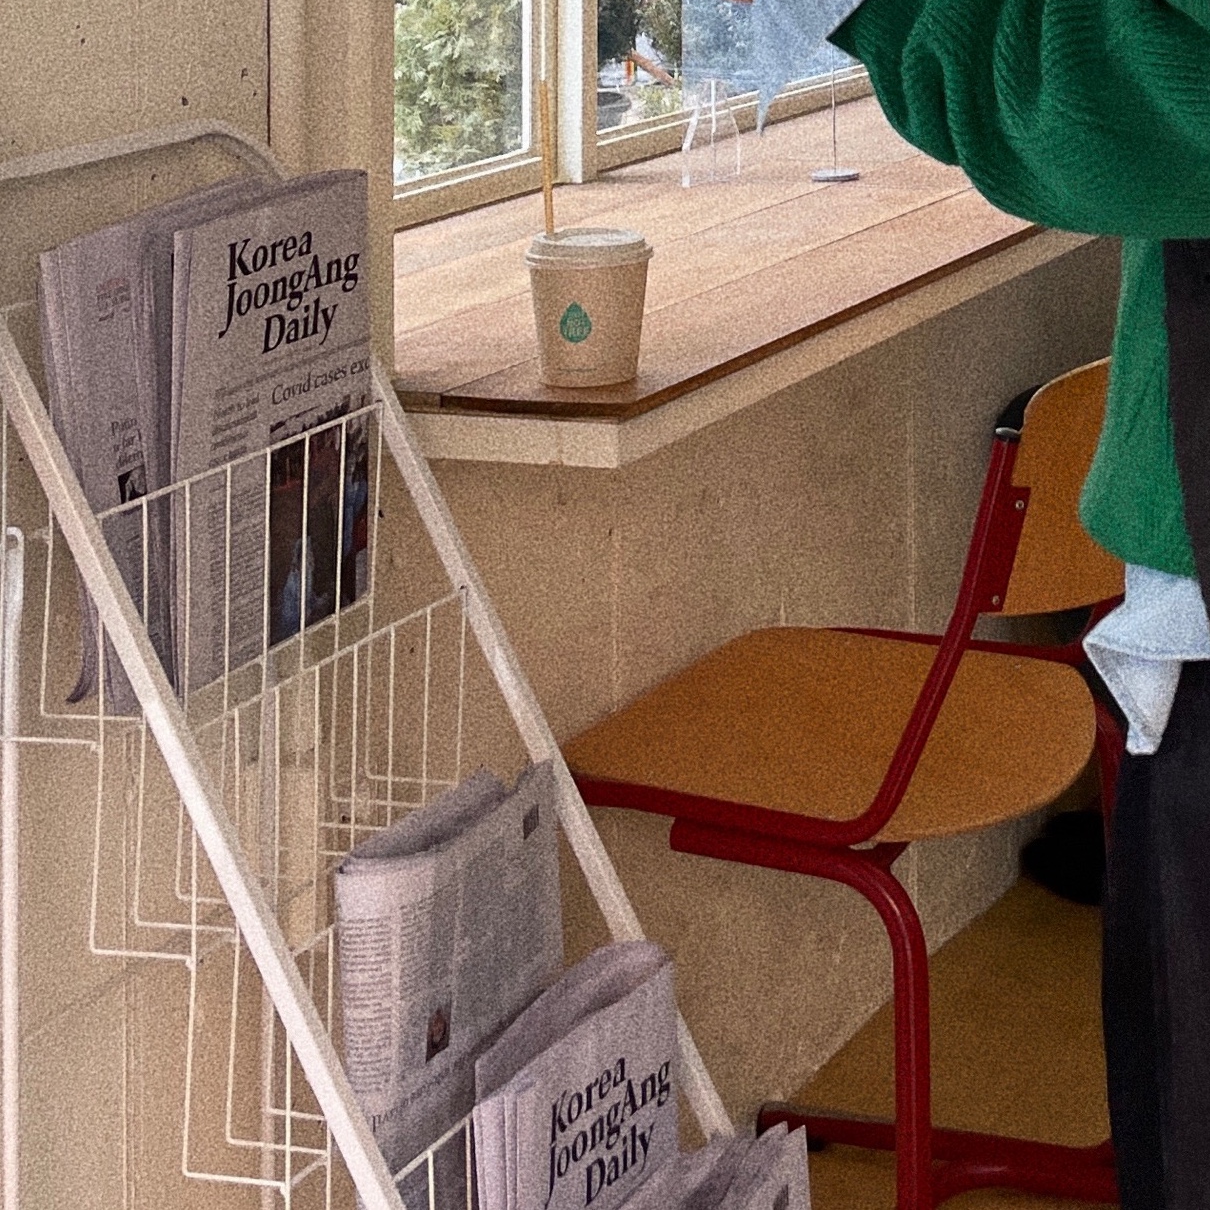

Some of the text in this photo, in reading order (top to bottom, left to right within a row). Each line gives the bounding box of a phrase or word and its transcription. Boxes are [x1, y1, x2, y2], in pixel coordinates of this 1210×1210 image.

[218, 253, 360, 339] JoongAng
[227, 231, 312, 281] Korea
[262, 296, 339, 354] Daily
[272, 369, 312, 405] Covid
[314, 365, 347, 388] cases
[544, 1060, 671, 1210] JoongAng
[550, 1057, 626, 1146] Korea
[584, 1122, 655, 1208] Daily
